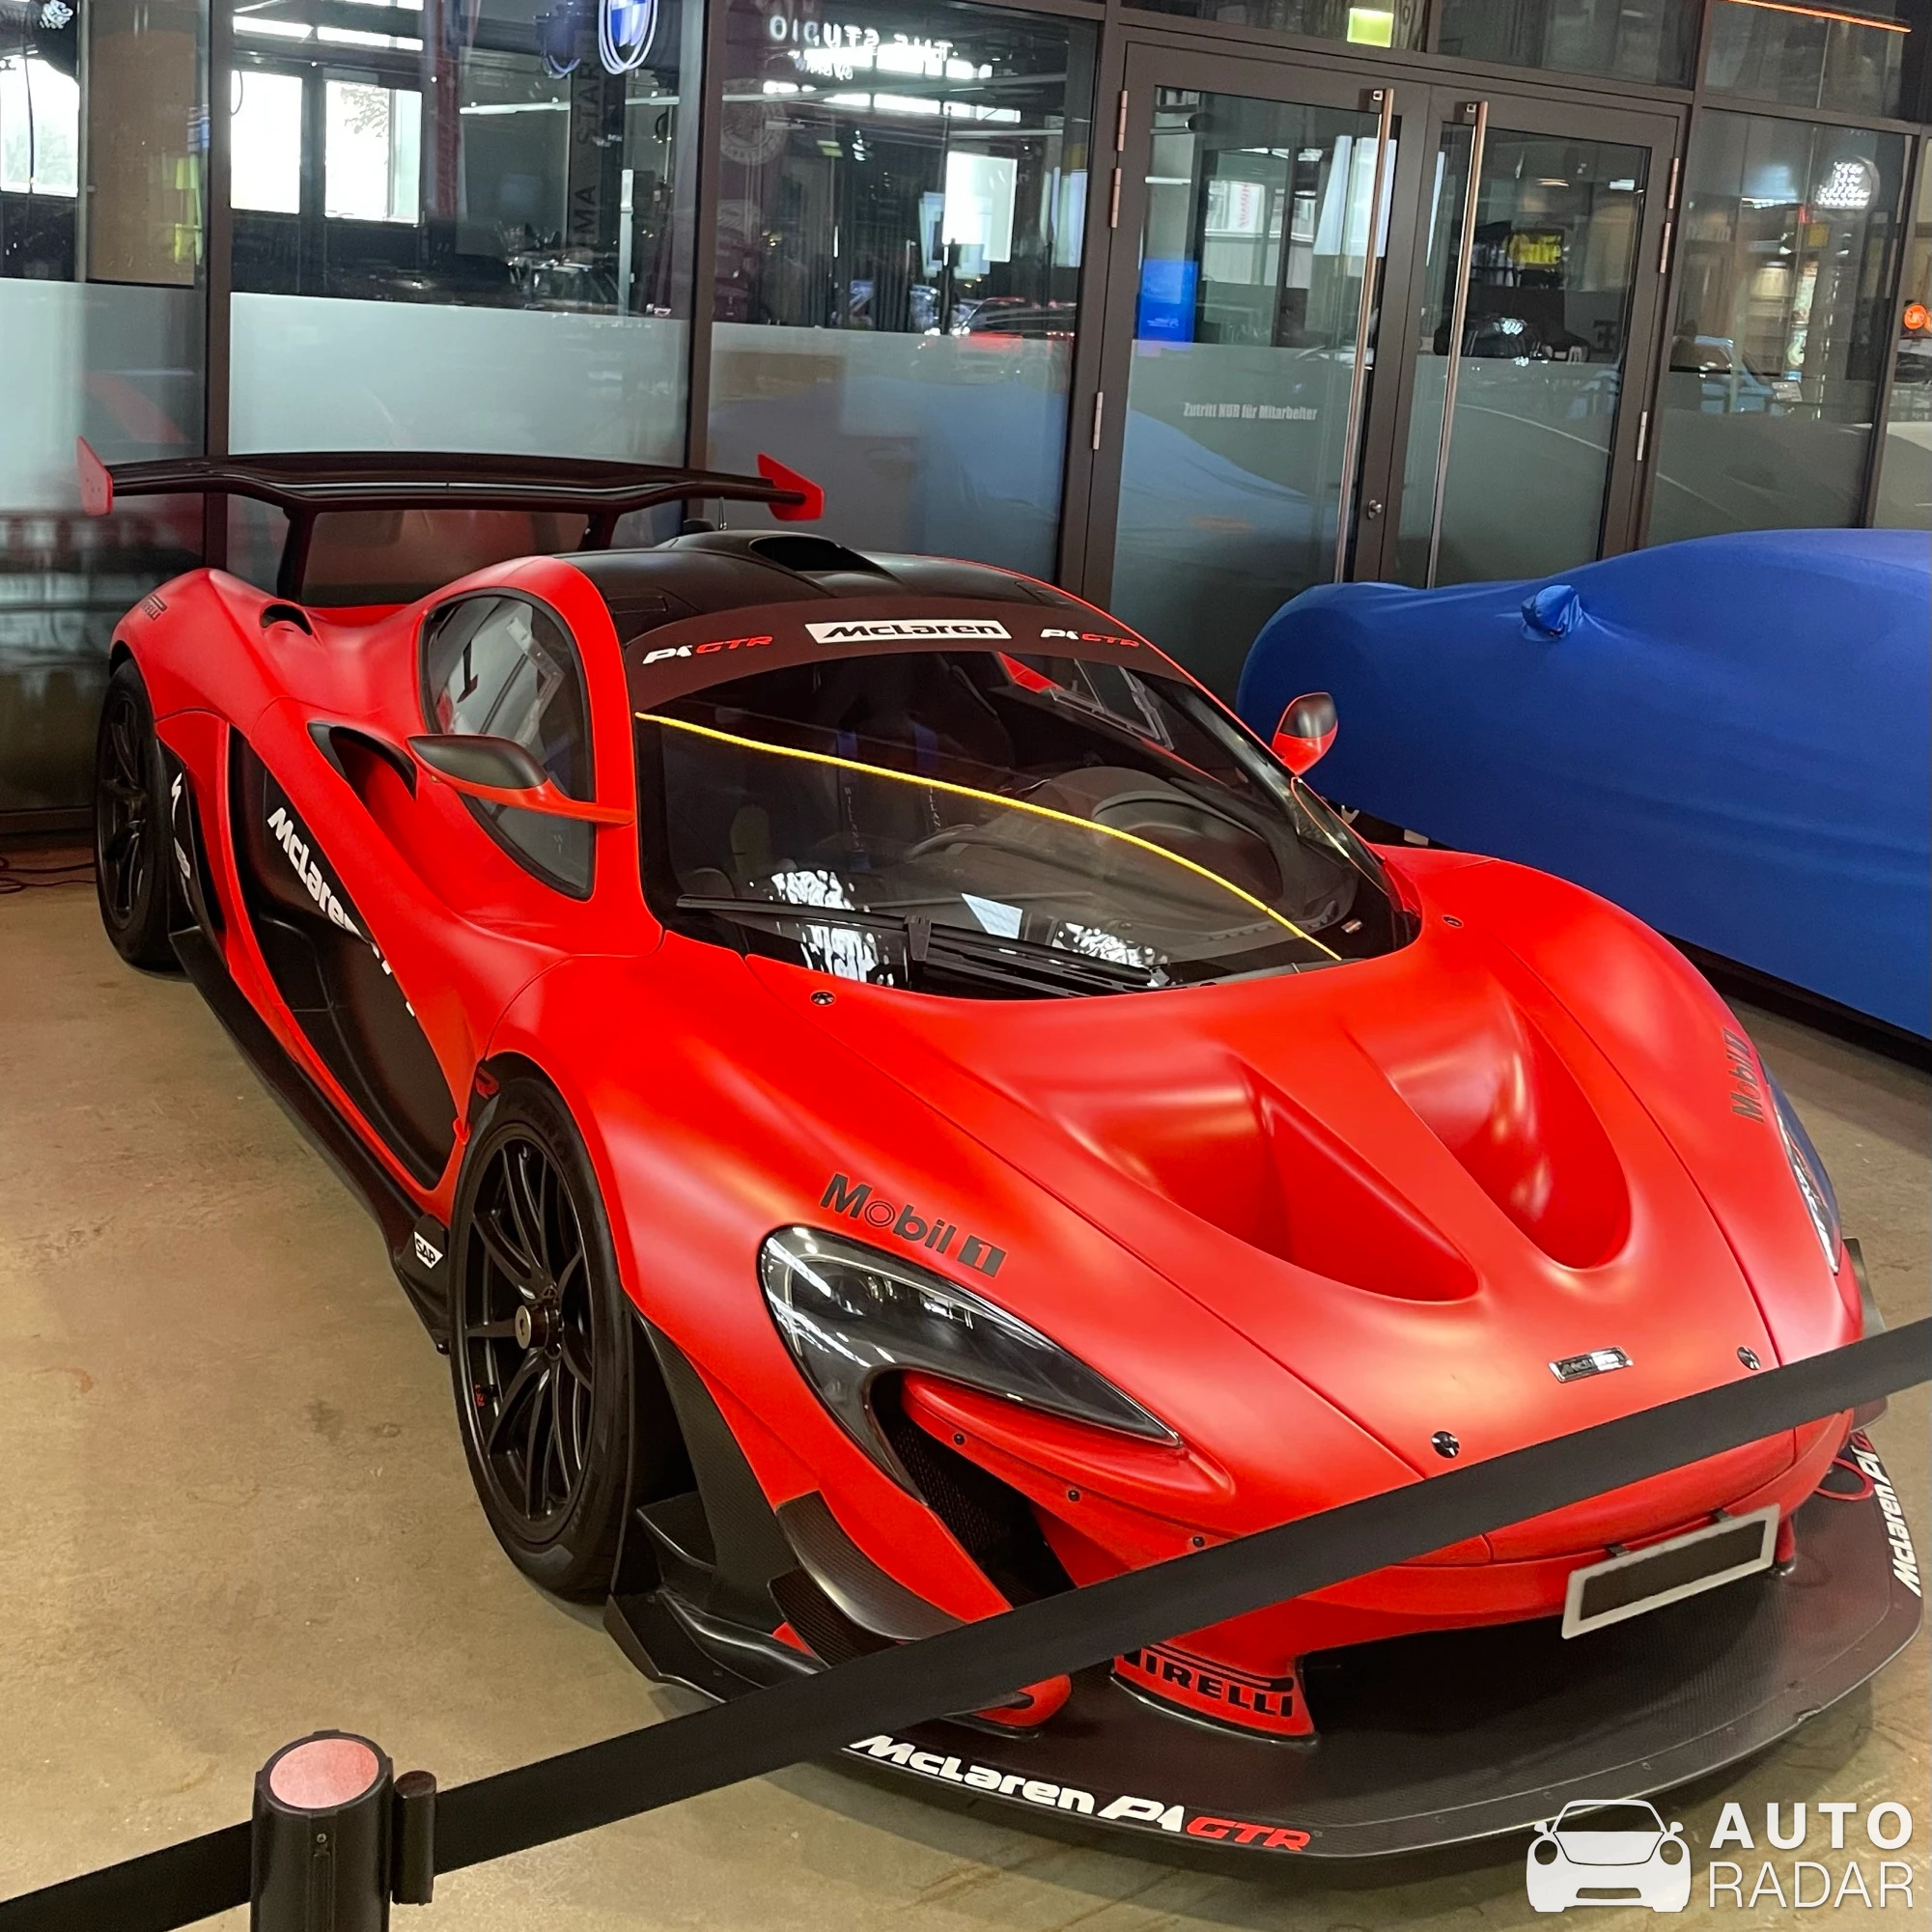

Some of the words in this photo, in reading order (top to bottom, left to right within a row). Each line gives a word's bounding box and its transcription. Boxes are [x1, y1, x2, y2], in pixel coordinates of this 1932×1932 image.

[1183, 403, 1218, 417] Zutritt
[1218, 404, 1241, 418] NUR
[1242, 404, 1258, 419] für
[1258, 405, 1318, 421] Mitarbeiter
[696, 635, 773, 654] GTR
[823, 624, 1002, 639] McLaren
[1726, 1049, 1765, 1123] Mobil
[820, 1173, 957, 1254] Mobil
[1873, 1483, 1922, 1598] McLaren
[849, 1735, 1096, 1815] McLaren
[1186, 1816, 1311, 1852] GTR
